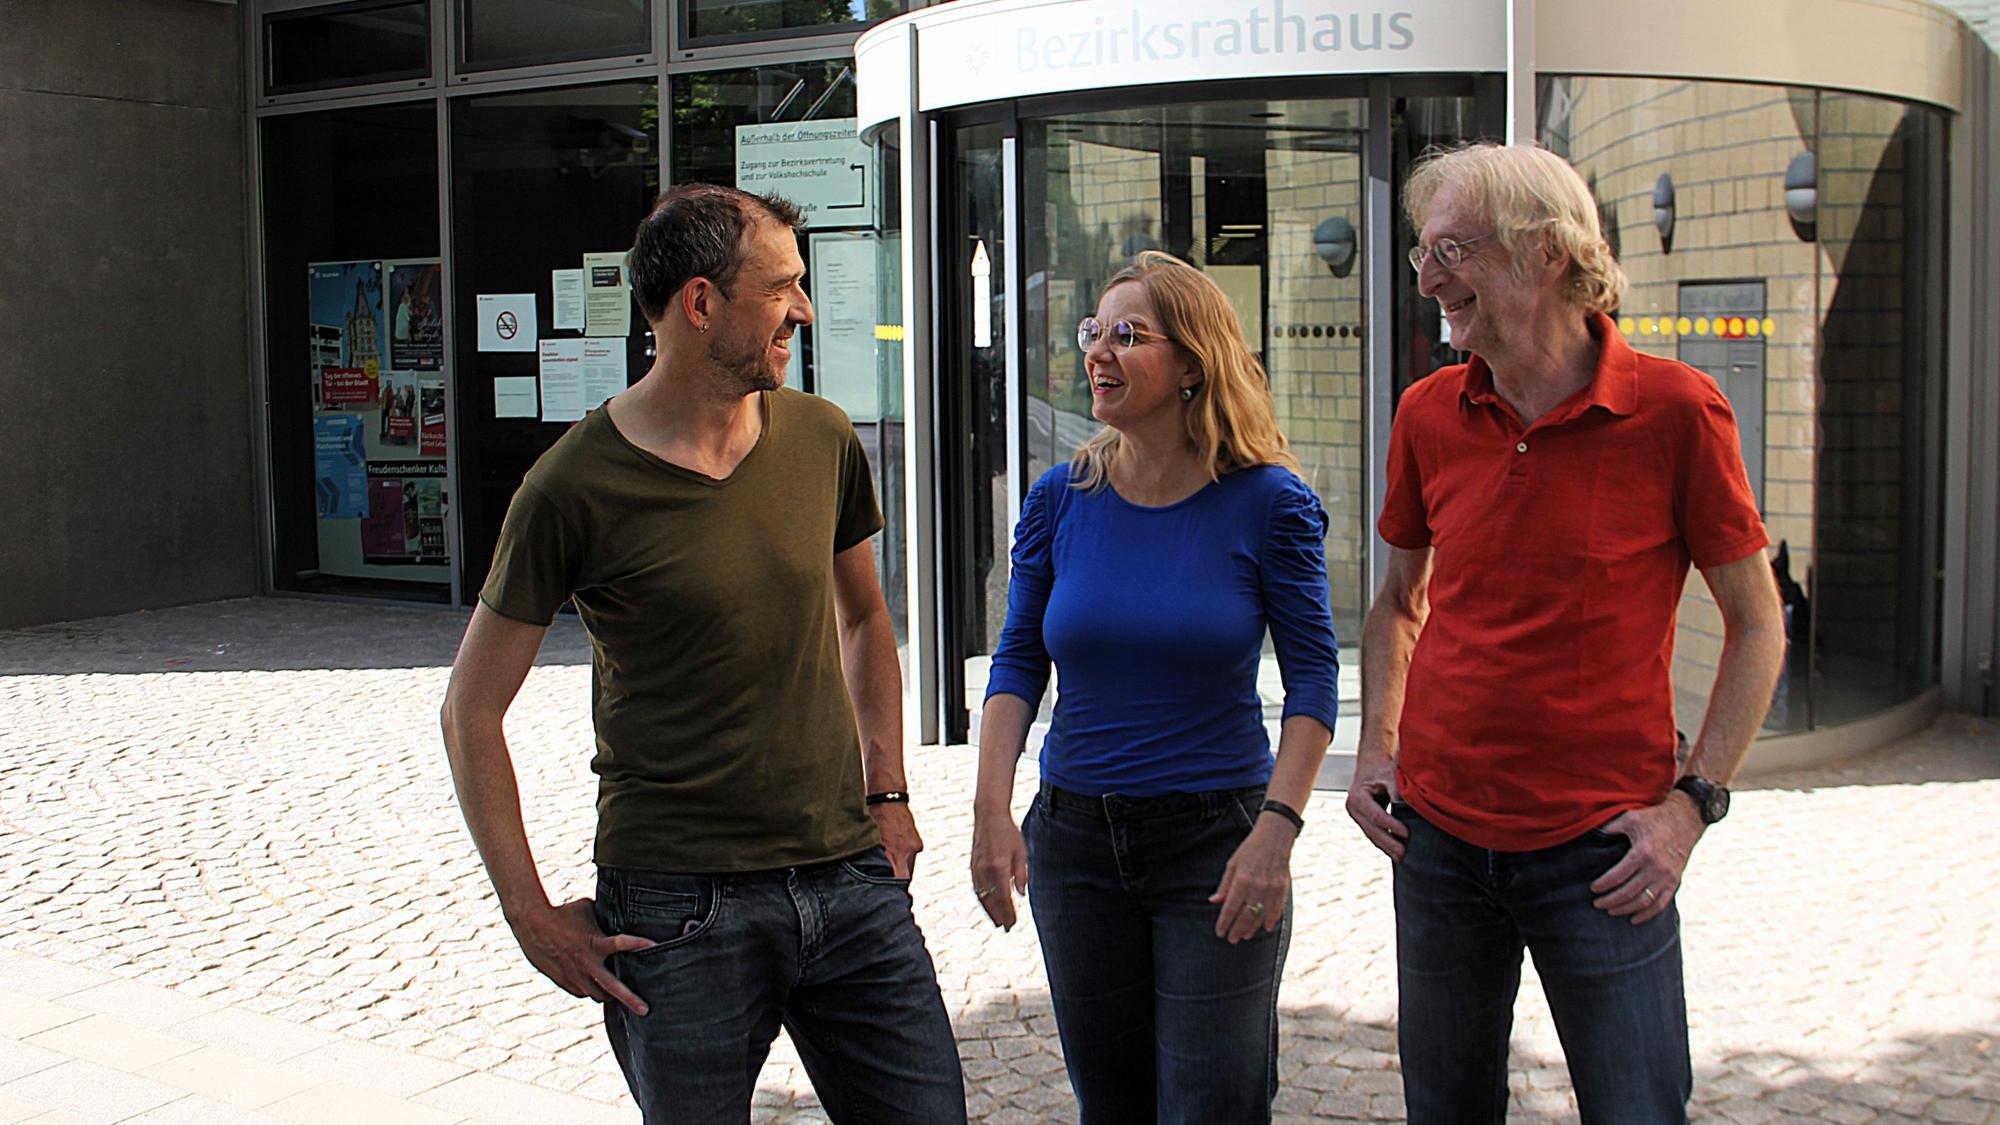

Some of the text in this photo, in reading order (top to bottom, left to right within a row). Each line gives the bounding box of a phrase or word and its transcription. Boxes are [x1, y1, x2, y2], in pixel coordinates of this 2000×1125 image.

[1016, 0, 1414, 73] Bezirksrathaus
[740, 128, 857, 144] Außerhalb der Öffnungszeiten
[740, 156, 846, 171] Zugang zur Bezirksvertretung
[740, 169, 827, 180] und zur Volkshochschule
[368, 464, 427, 475] Freudenschenker
